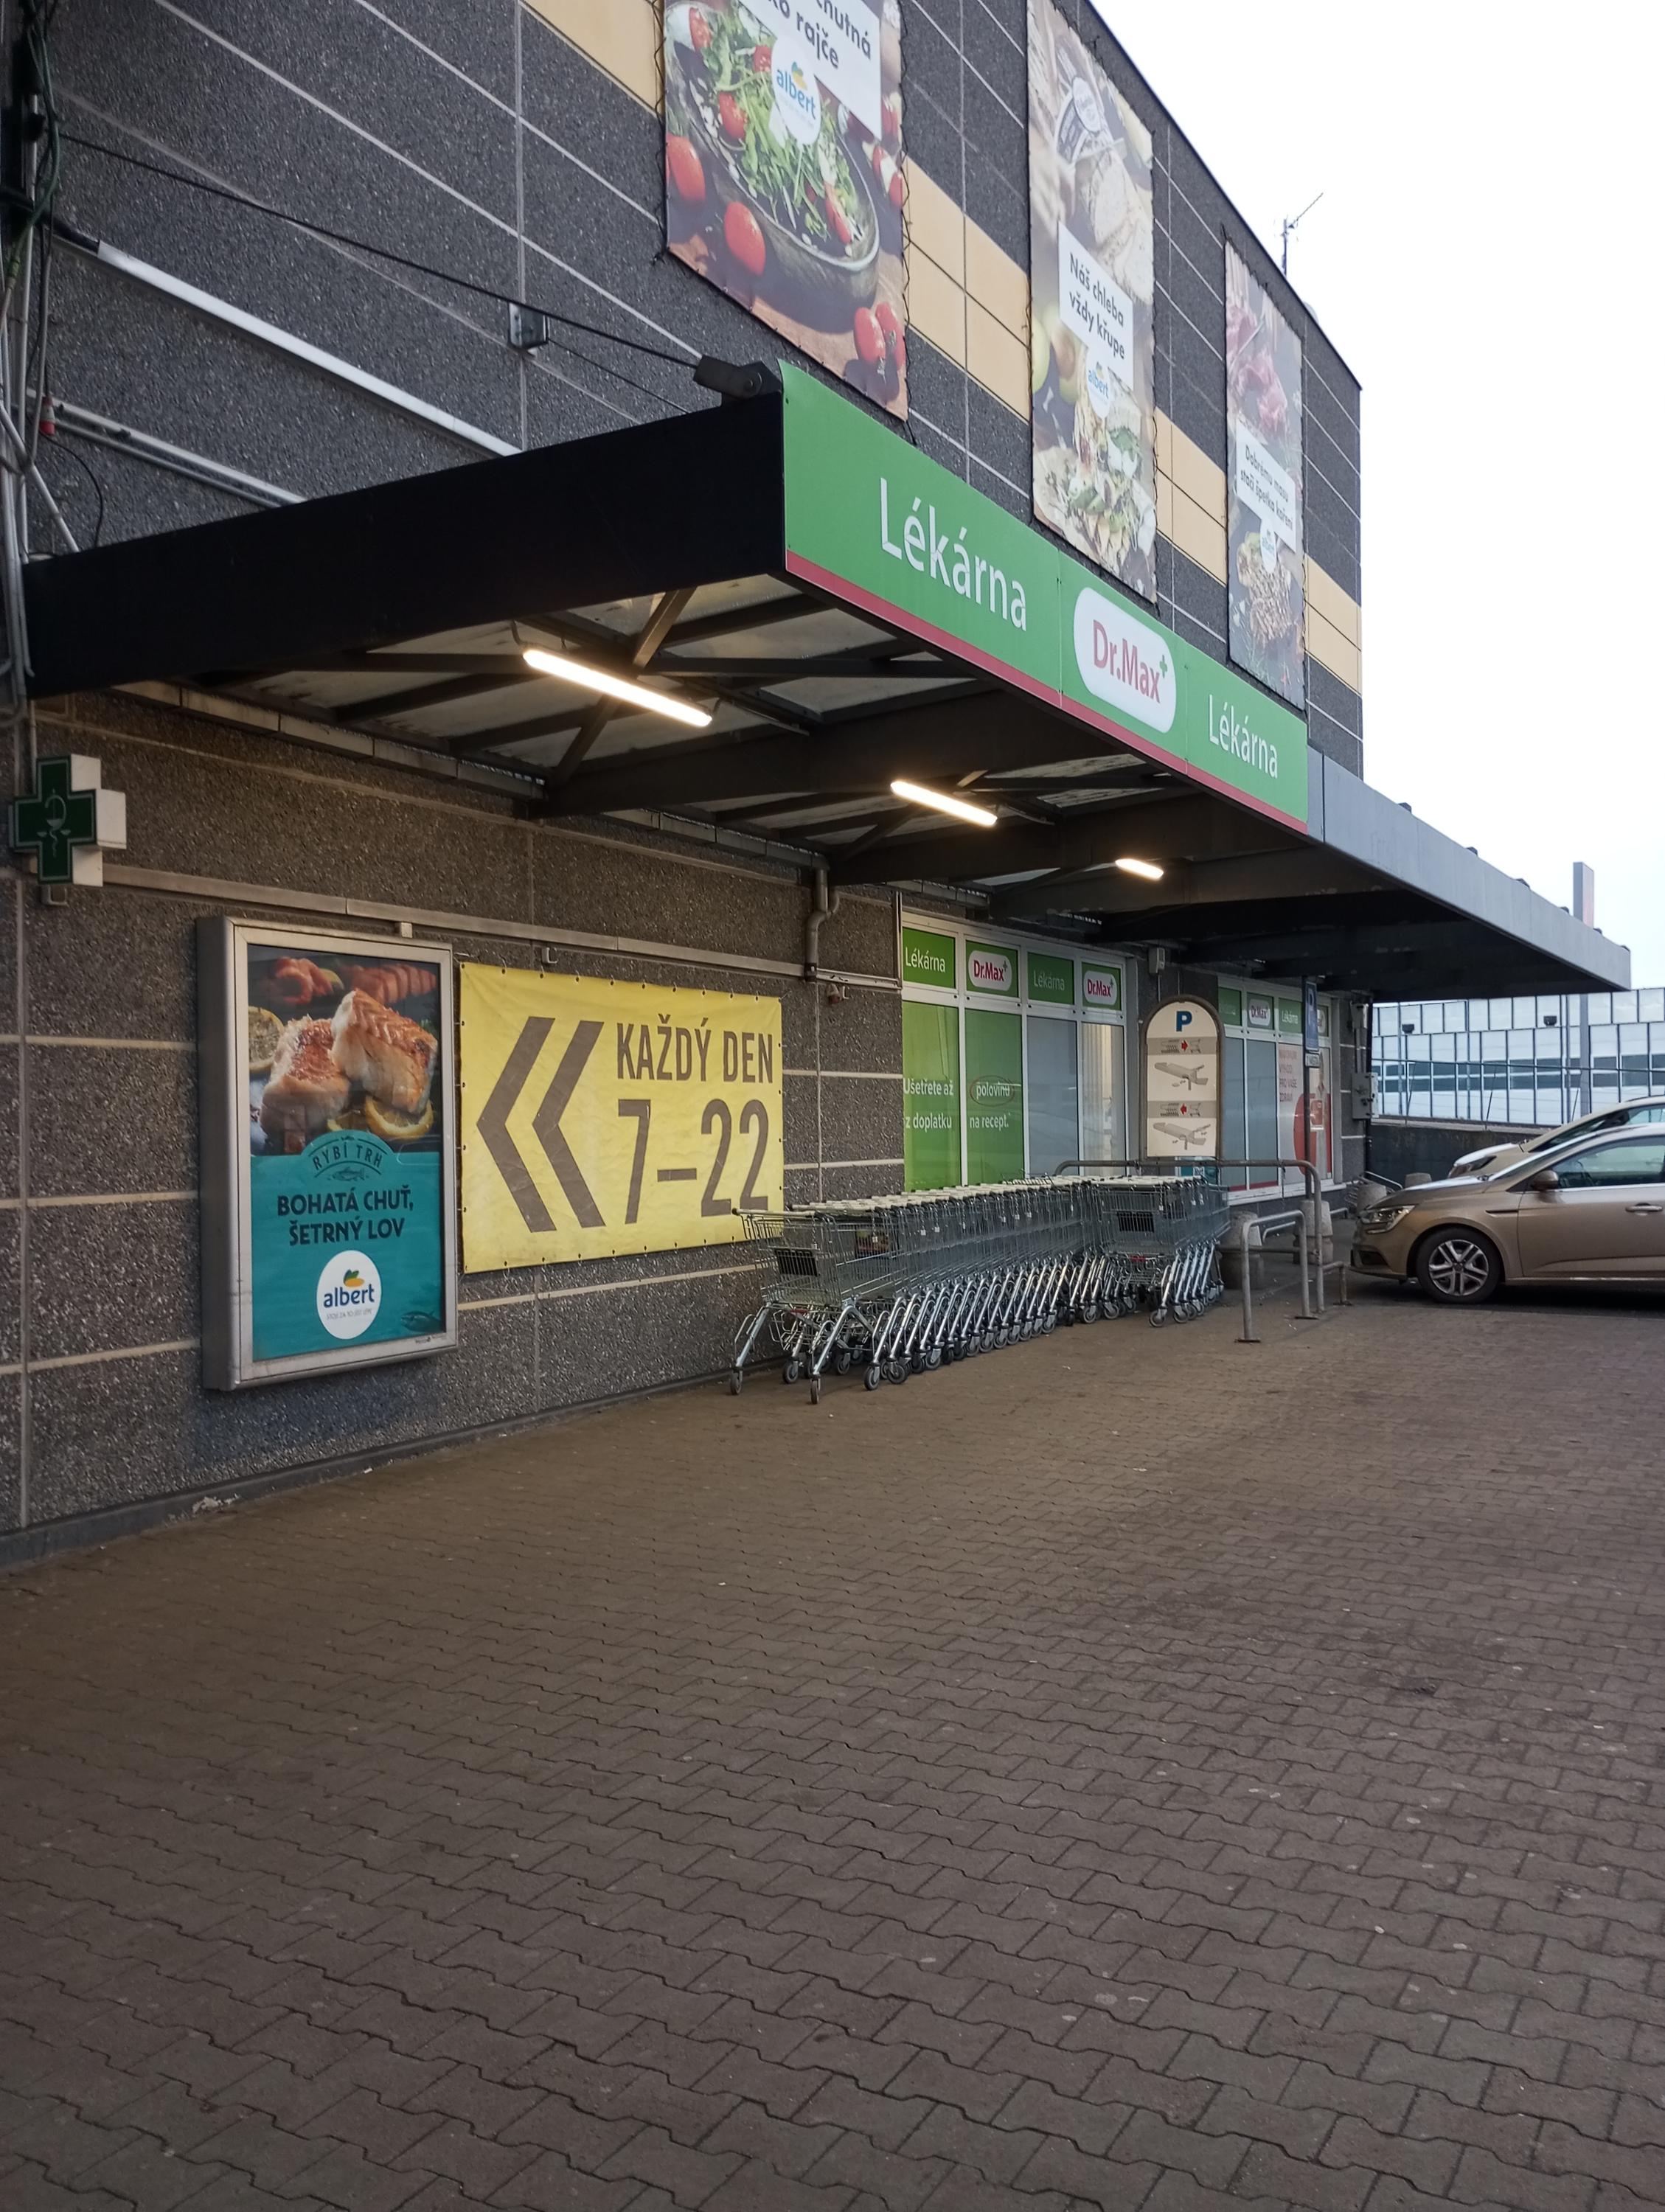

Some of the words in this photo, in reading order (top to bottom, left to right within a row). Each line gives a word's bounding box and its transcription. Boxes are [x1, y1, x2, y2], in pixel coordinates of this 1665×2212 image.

[796, 11, 839, 69] rajče
[776, 69, 816, 119] albert
[1070, 252, 1091, 291] Náš
[1092, 280, 1124, 327] chleba
[1069, 291, 1094, 333] vždy
[1096, 313, 1125, 360] křupe
[1088, 369, 1109, 399] albert
[1245, 445, 1273, 486] Dobrému
[880, 477, 1026, 632] Lékárna
[1093, 619, 1161, 704] Dr.Max
[1209, 694, 1278, 779] Lékárna
[905, 947, 945, 973] Lékárna
[973, 960, 1004, 982] Dr.Max
[1033, 970, 1065, 991] Lékárna
[1088, 978, 1111, 997] Dr.Max
[1175, 1010, 1192, 1032] P
[616, 1013, 712, 1082] KAŽDÝ
[723, 1030, 774, 1084] DEN
[903, 1078, 942, 1095] Ušetřete
[943, 1080, 953, 1096] až
[976, 1082, 1010, 1100] polovinu
[905, 1117, 911, 1129] z
[913, 1112, 952, 1133] doplatku
[970, 1118, 980, 1128] na
[312, 1142, 348, 1171] RYBÍ
[356, 1144, 383, 1168] TRH
[277, 1187, 359, 1217] BOHATÁ
[364, 1184, 414, 1211] CHUŤ,
[289, 1216, 364, 1247] ŠETRNÝ
[368, 1217, 405, 1239] LOV
[323, 1284, 375, 1309] albert
